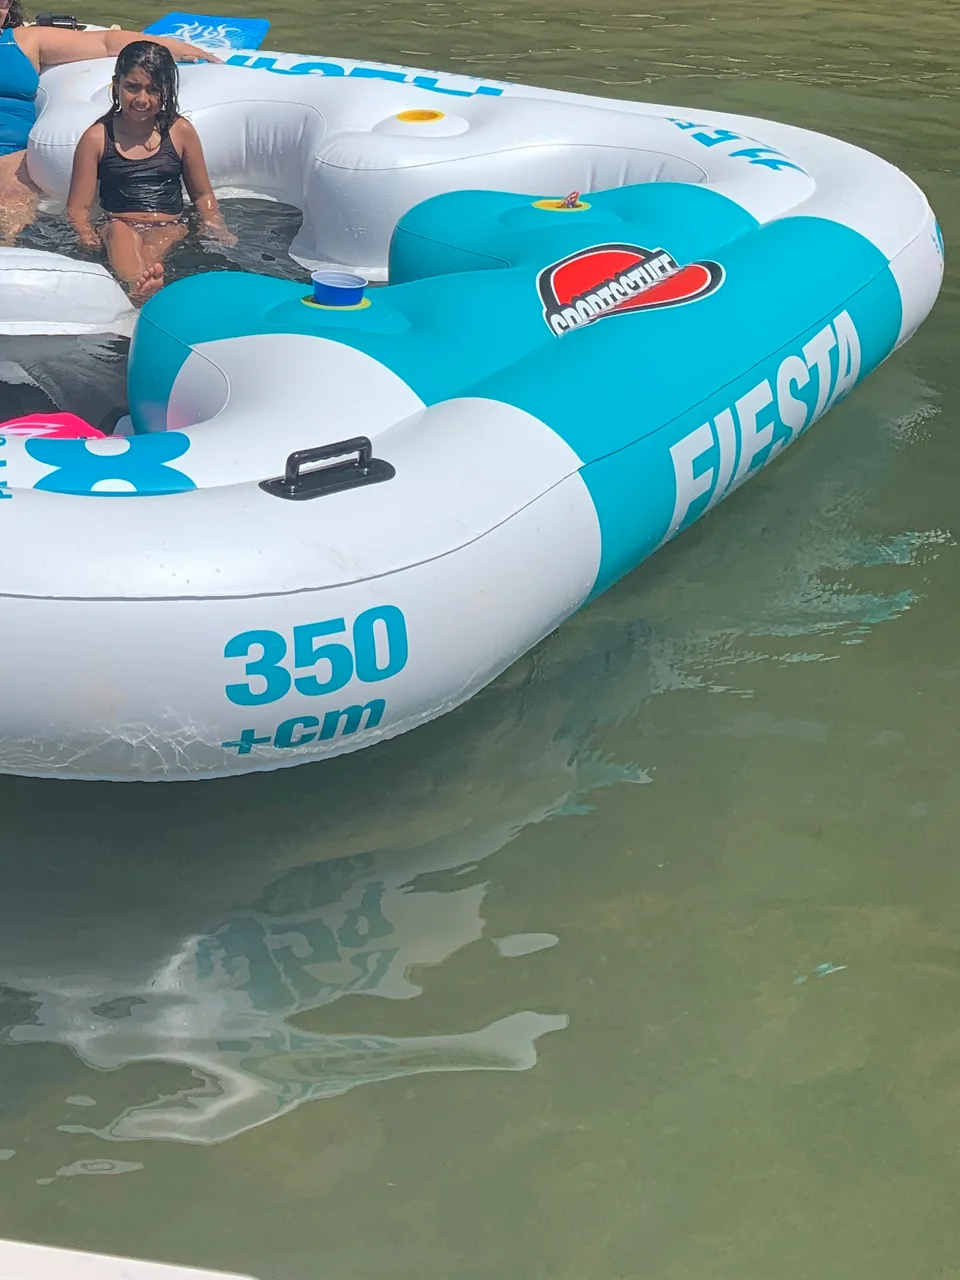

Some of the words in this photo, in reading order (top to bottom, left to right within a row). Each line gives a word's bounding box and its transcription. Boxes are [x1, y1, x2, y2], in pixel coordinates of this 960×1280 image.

[653, 309, 862, 556] FIESTA
[223, 604, 409, 707] 350
[221, 698, 387, 755] +cm
